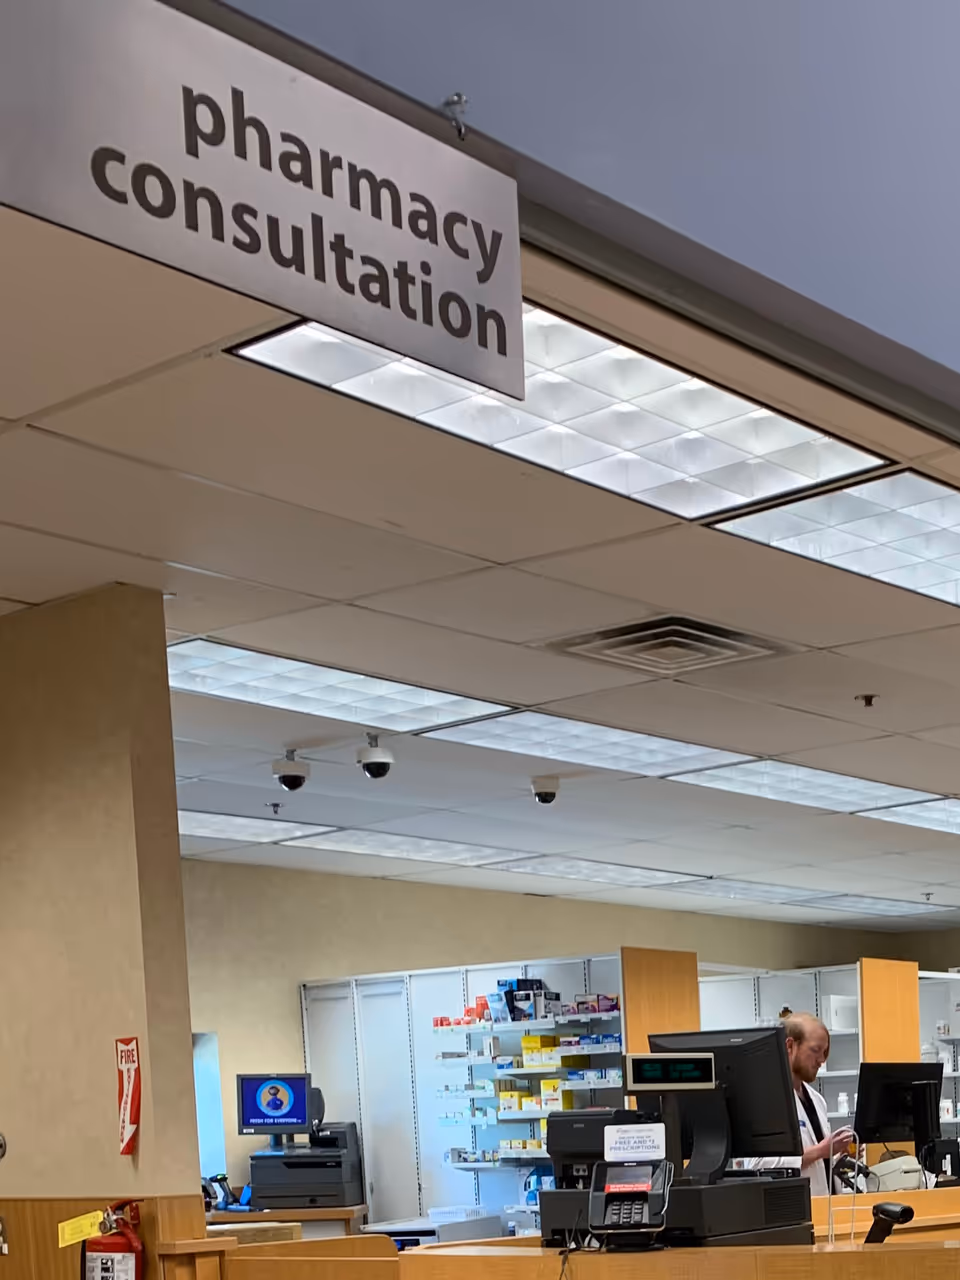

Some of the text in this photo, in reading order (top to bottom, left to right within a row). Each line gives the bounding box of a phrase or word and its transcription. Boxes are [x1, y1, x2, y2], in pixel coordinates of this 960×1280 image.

[90, 145, 508, 358] consultation
[181, 85, 503, 284] pharmacy
[120, 1048, 136, 1064] FIRE
